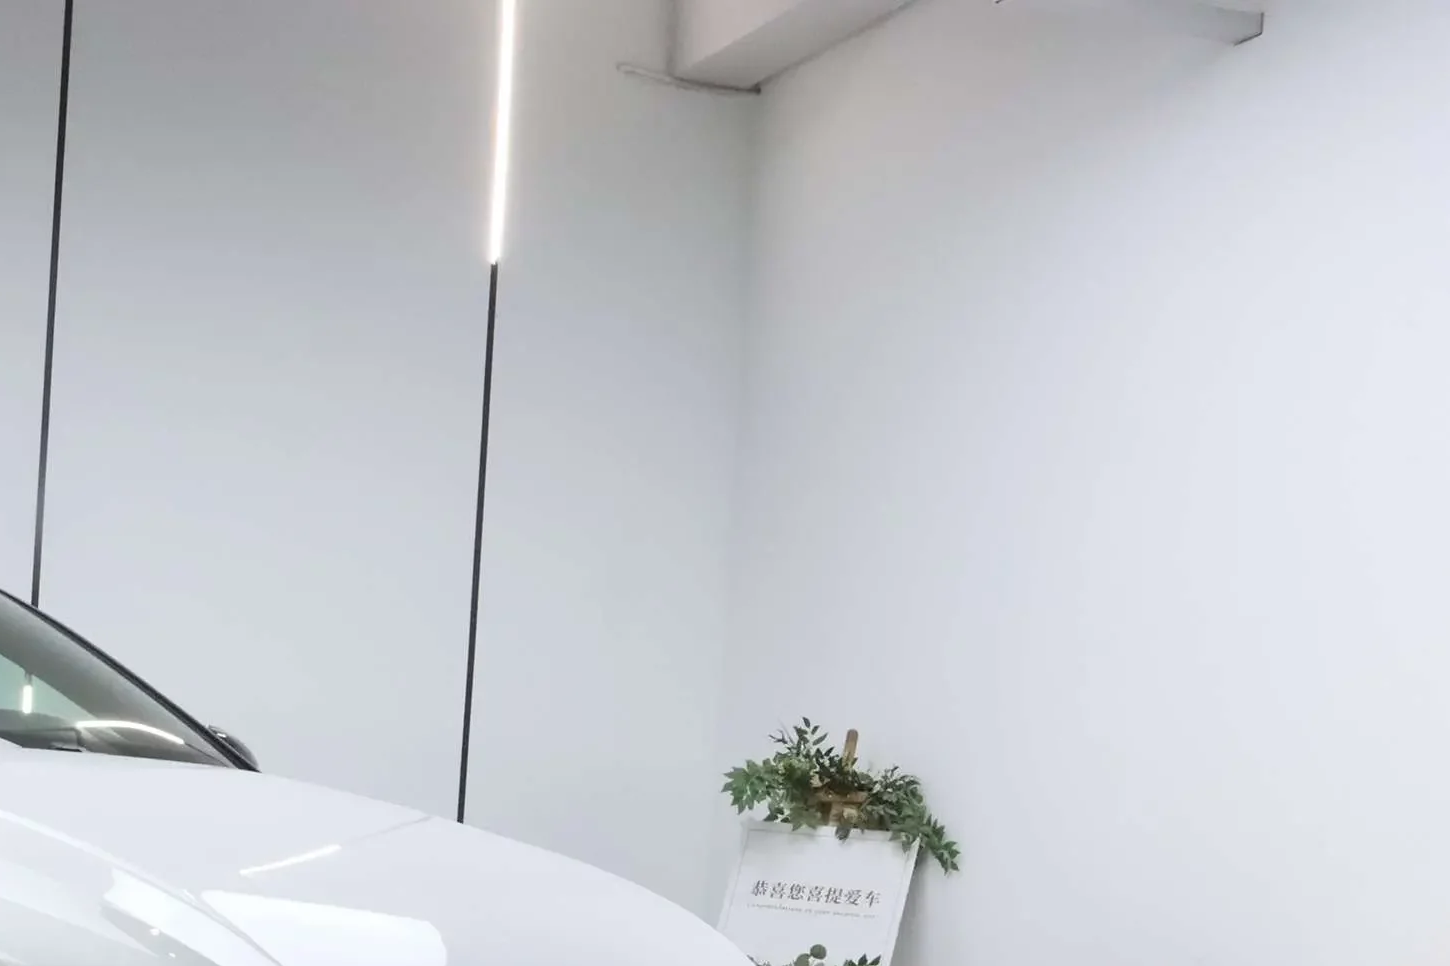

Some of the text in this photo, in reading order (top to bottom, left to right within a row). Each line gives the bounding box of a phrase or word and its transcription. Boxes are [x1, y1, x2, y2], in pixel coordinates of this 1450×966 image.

[751, 879, 881, 908] 恭喜您喜提爱车
